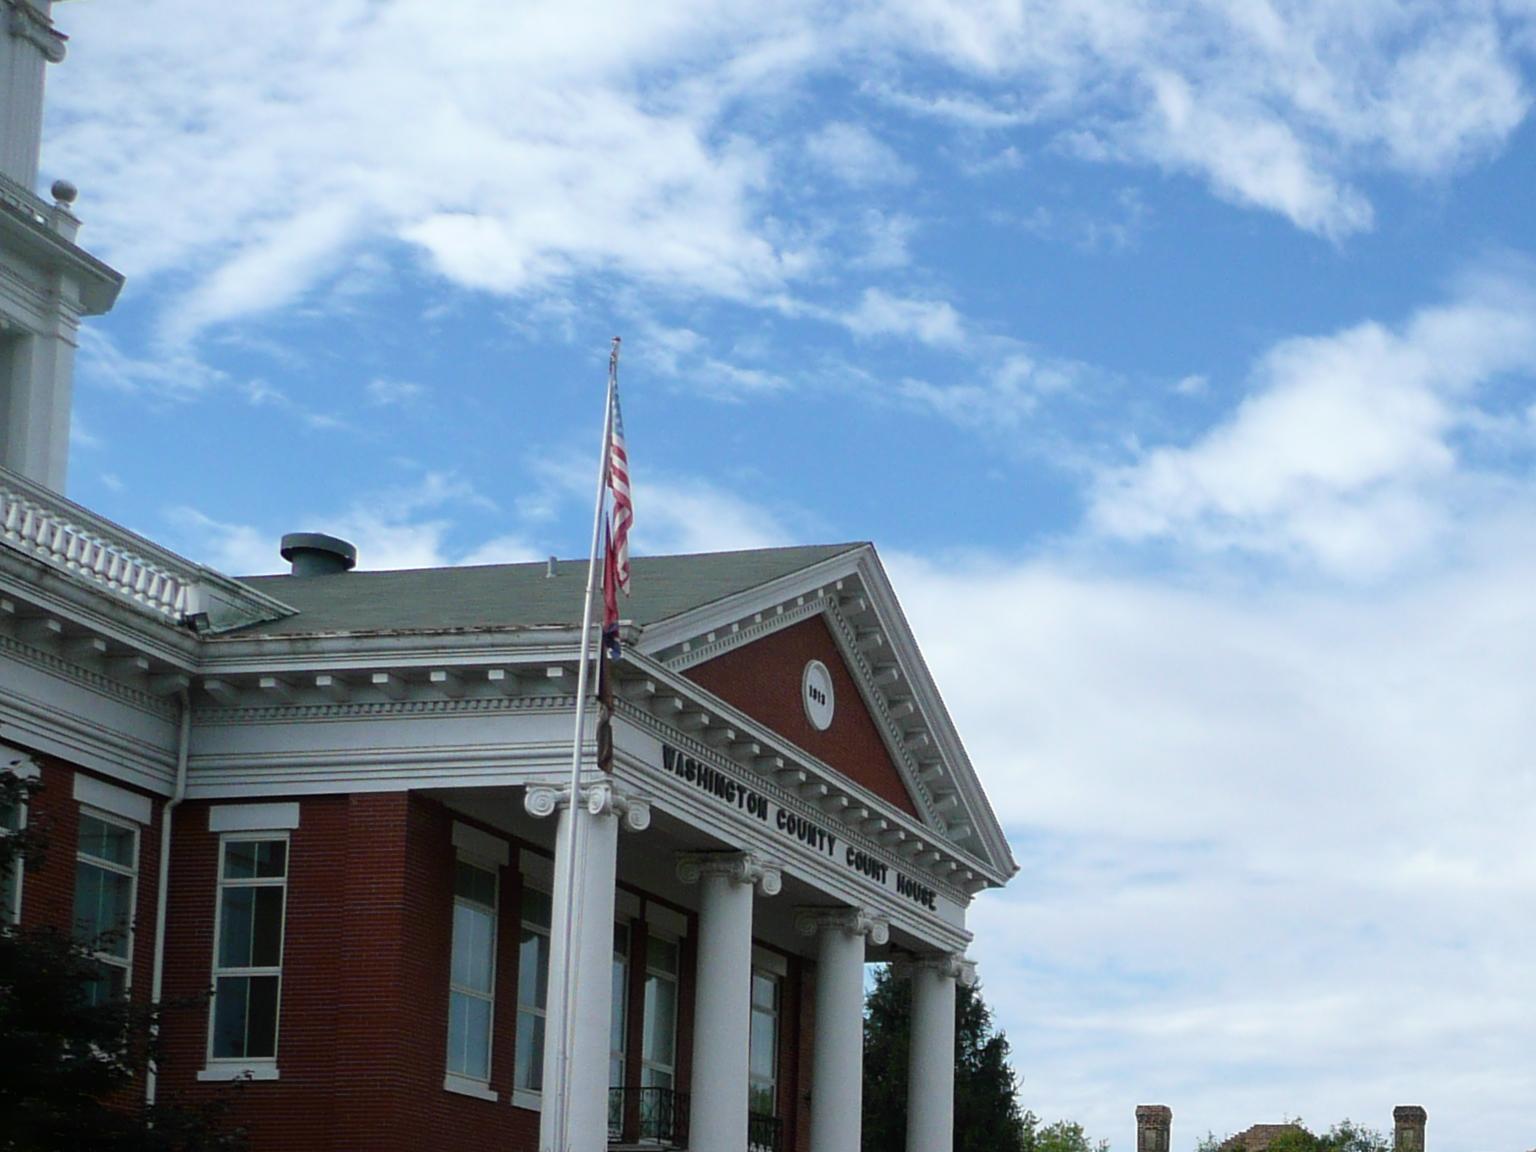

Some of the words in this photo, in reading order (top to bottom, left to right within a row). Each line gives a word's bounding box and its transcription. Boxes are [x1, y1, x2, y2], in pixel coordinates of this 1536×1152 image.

[662, 745, 768, 821] WASHINGTON
[776, 809, 836, 856] COUNTY
[846, 847, 888, 885] COURT
[897, 873, 937, 911] HOUSE
